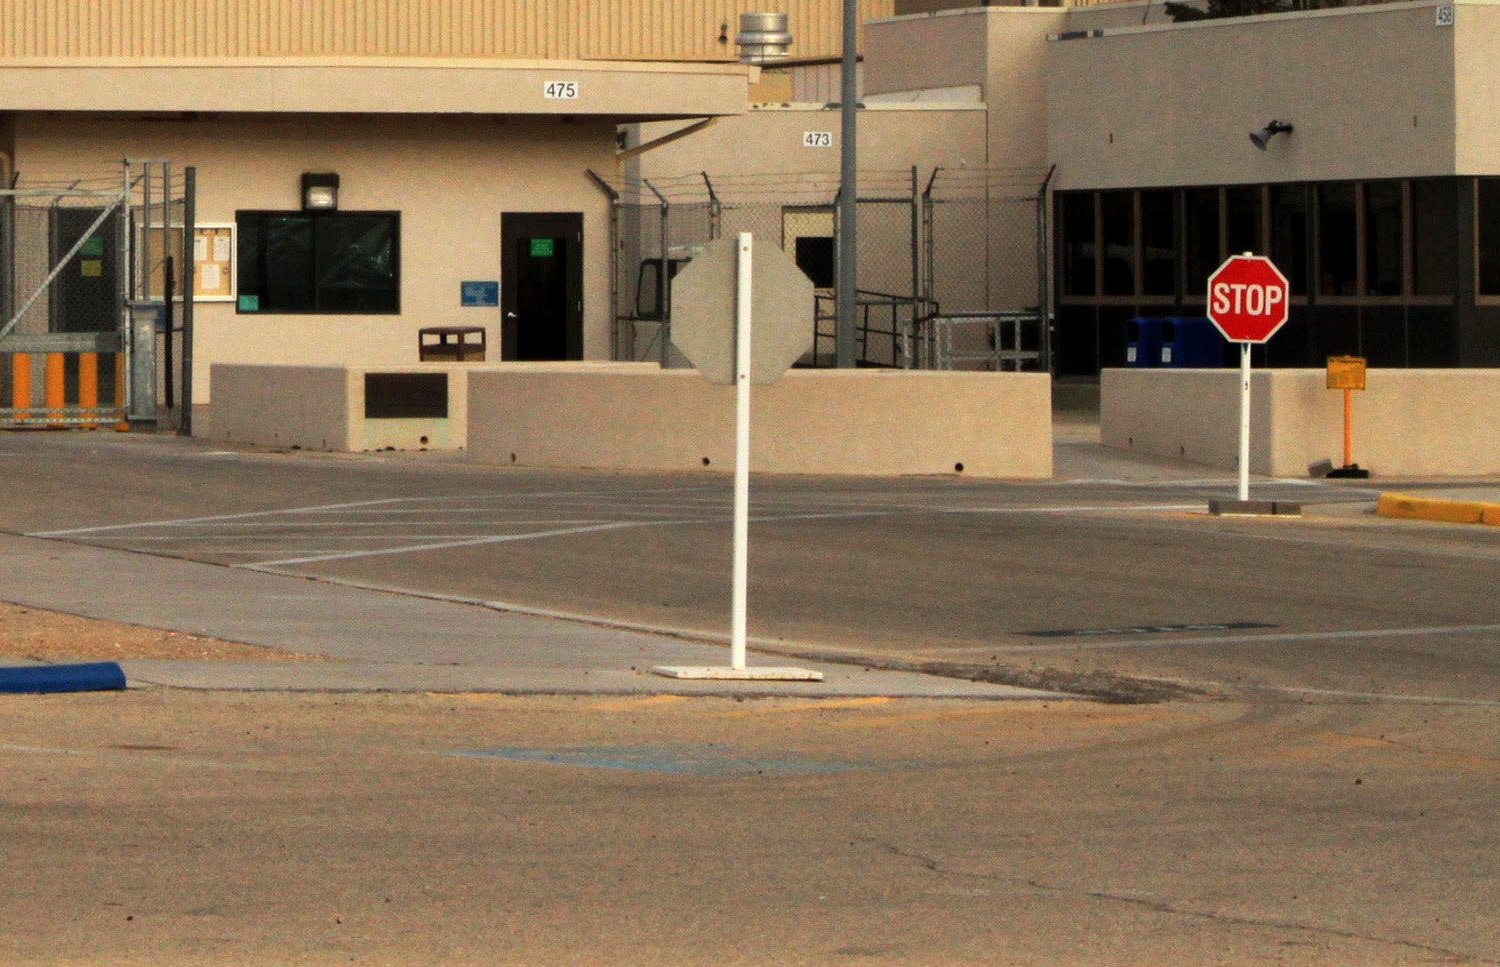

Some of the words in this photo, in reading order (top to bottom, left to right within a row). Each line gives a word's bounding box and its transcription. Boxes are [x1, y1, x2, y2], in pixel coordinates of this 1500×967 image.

[546, 83, 576, 97] 475
[805, 133, 830, 146] 473
[1213, 282, 1283, 316] STOP
